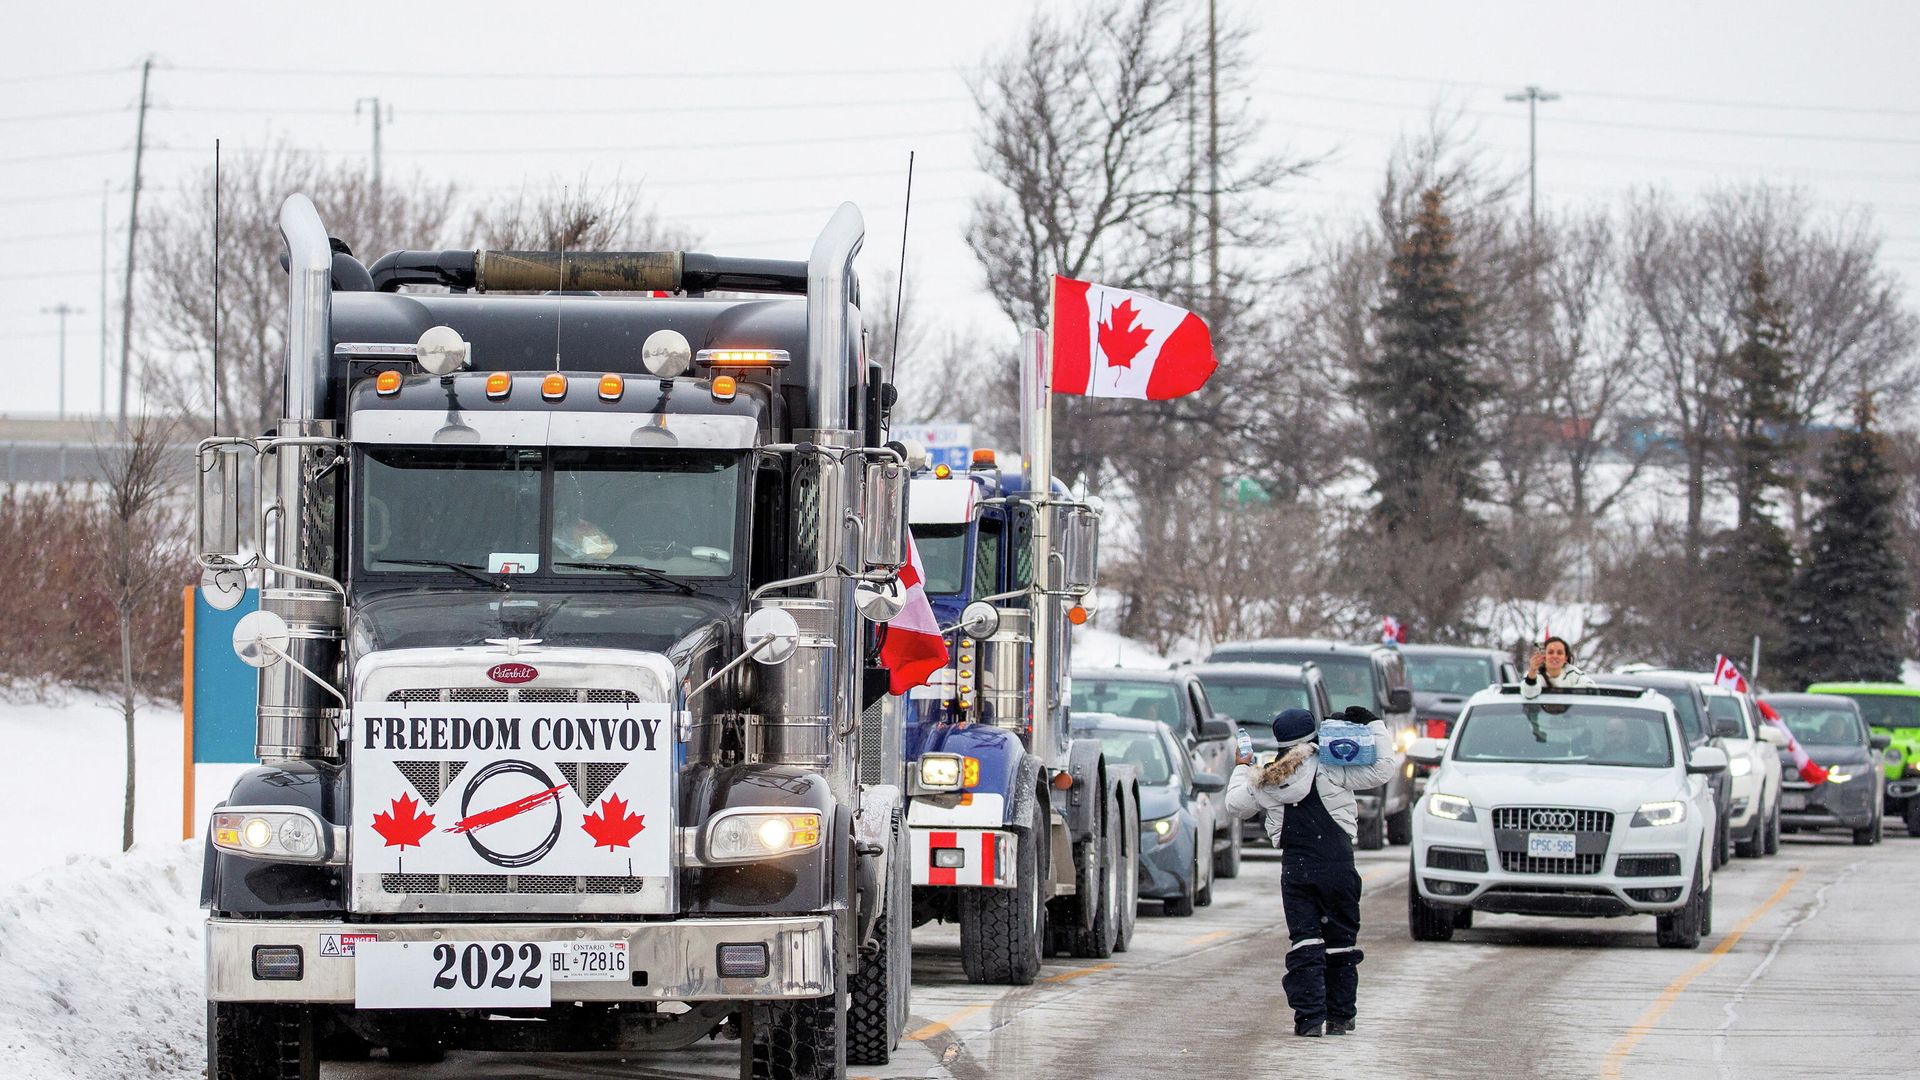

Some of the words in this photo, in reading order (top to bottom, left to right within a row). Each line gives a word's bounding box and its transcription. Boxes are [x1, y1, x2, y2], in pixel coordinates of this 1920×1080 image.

[492, 666, 535, 679] Peterbilt
[364, 717, 521, 750] FREEDOM
[531, 718, 661, 751] CONVOY
[1531, 839, 1552, 852] CPSC
[1557, 840, 1574, 853] 585
[433, 943, 543, 990] 2022
[552, 953, 570, 971] BL
[580, 952, 625, 971] 72816
